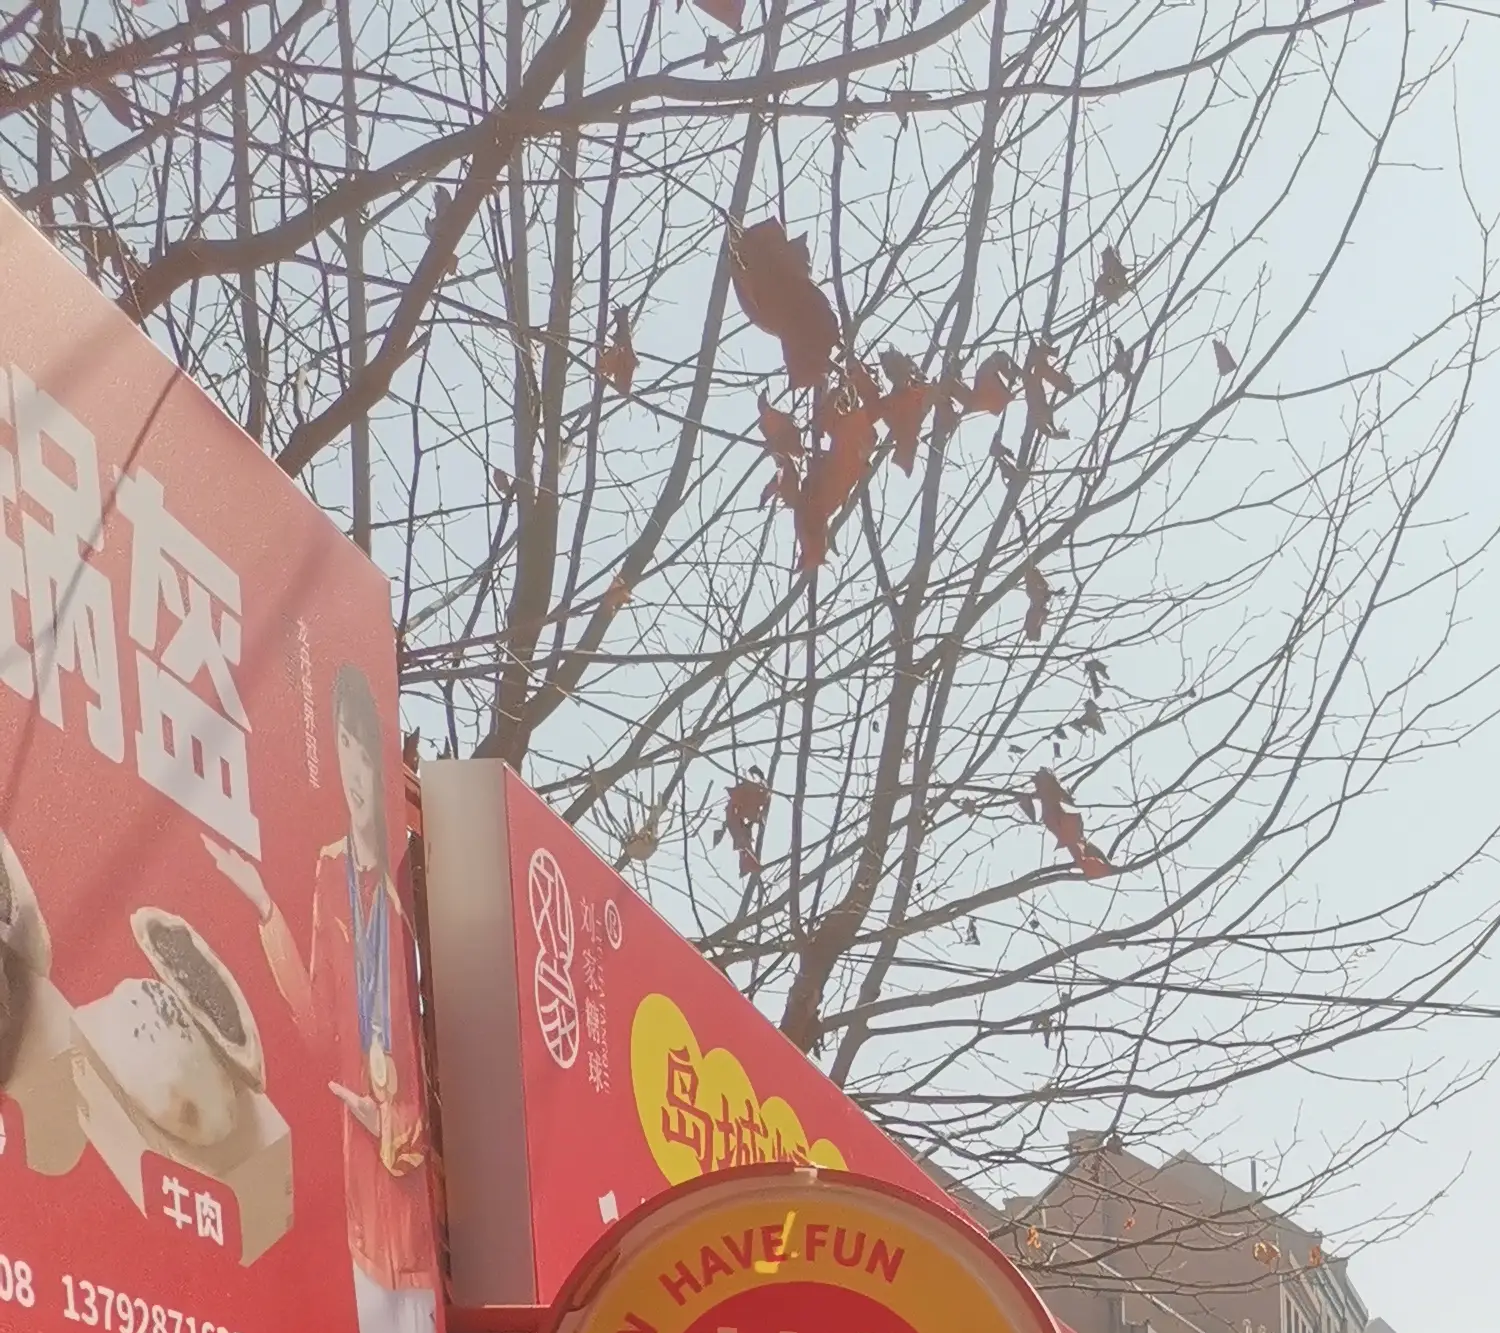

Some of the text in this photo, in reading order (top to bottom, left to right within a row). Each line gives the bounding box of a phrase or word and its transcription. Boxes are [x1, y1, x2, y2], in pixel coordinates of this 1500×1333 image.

[161, 1175, 225, 1247] 牛肉
[658, 1224, 905, 1306] HAVE FUN
